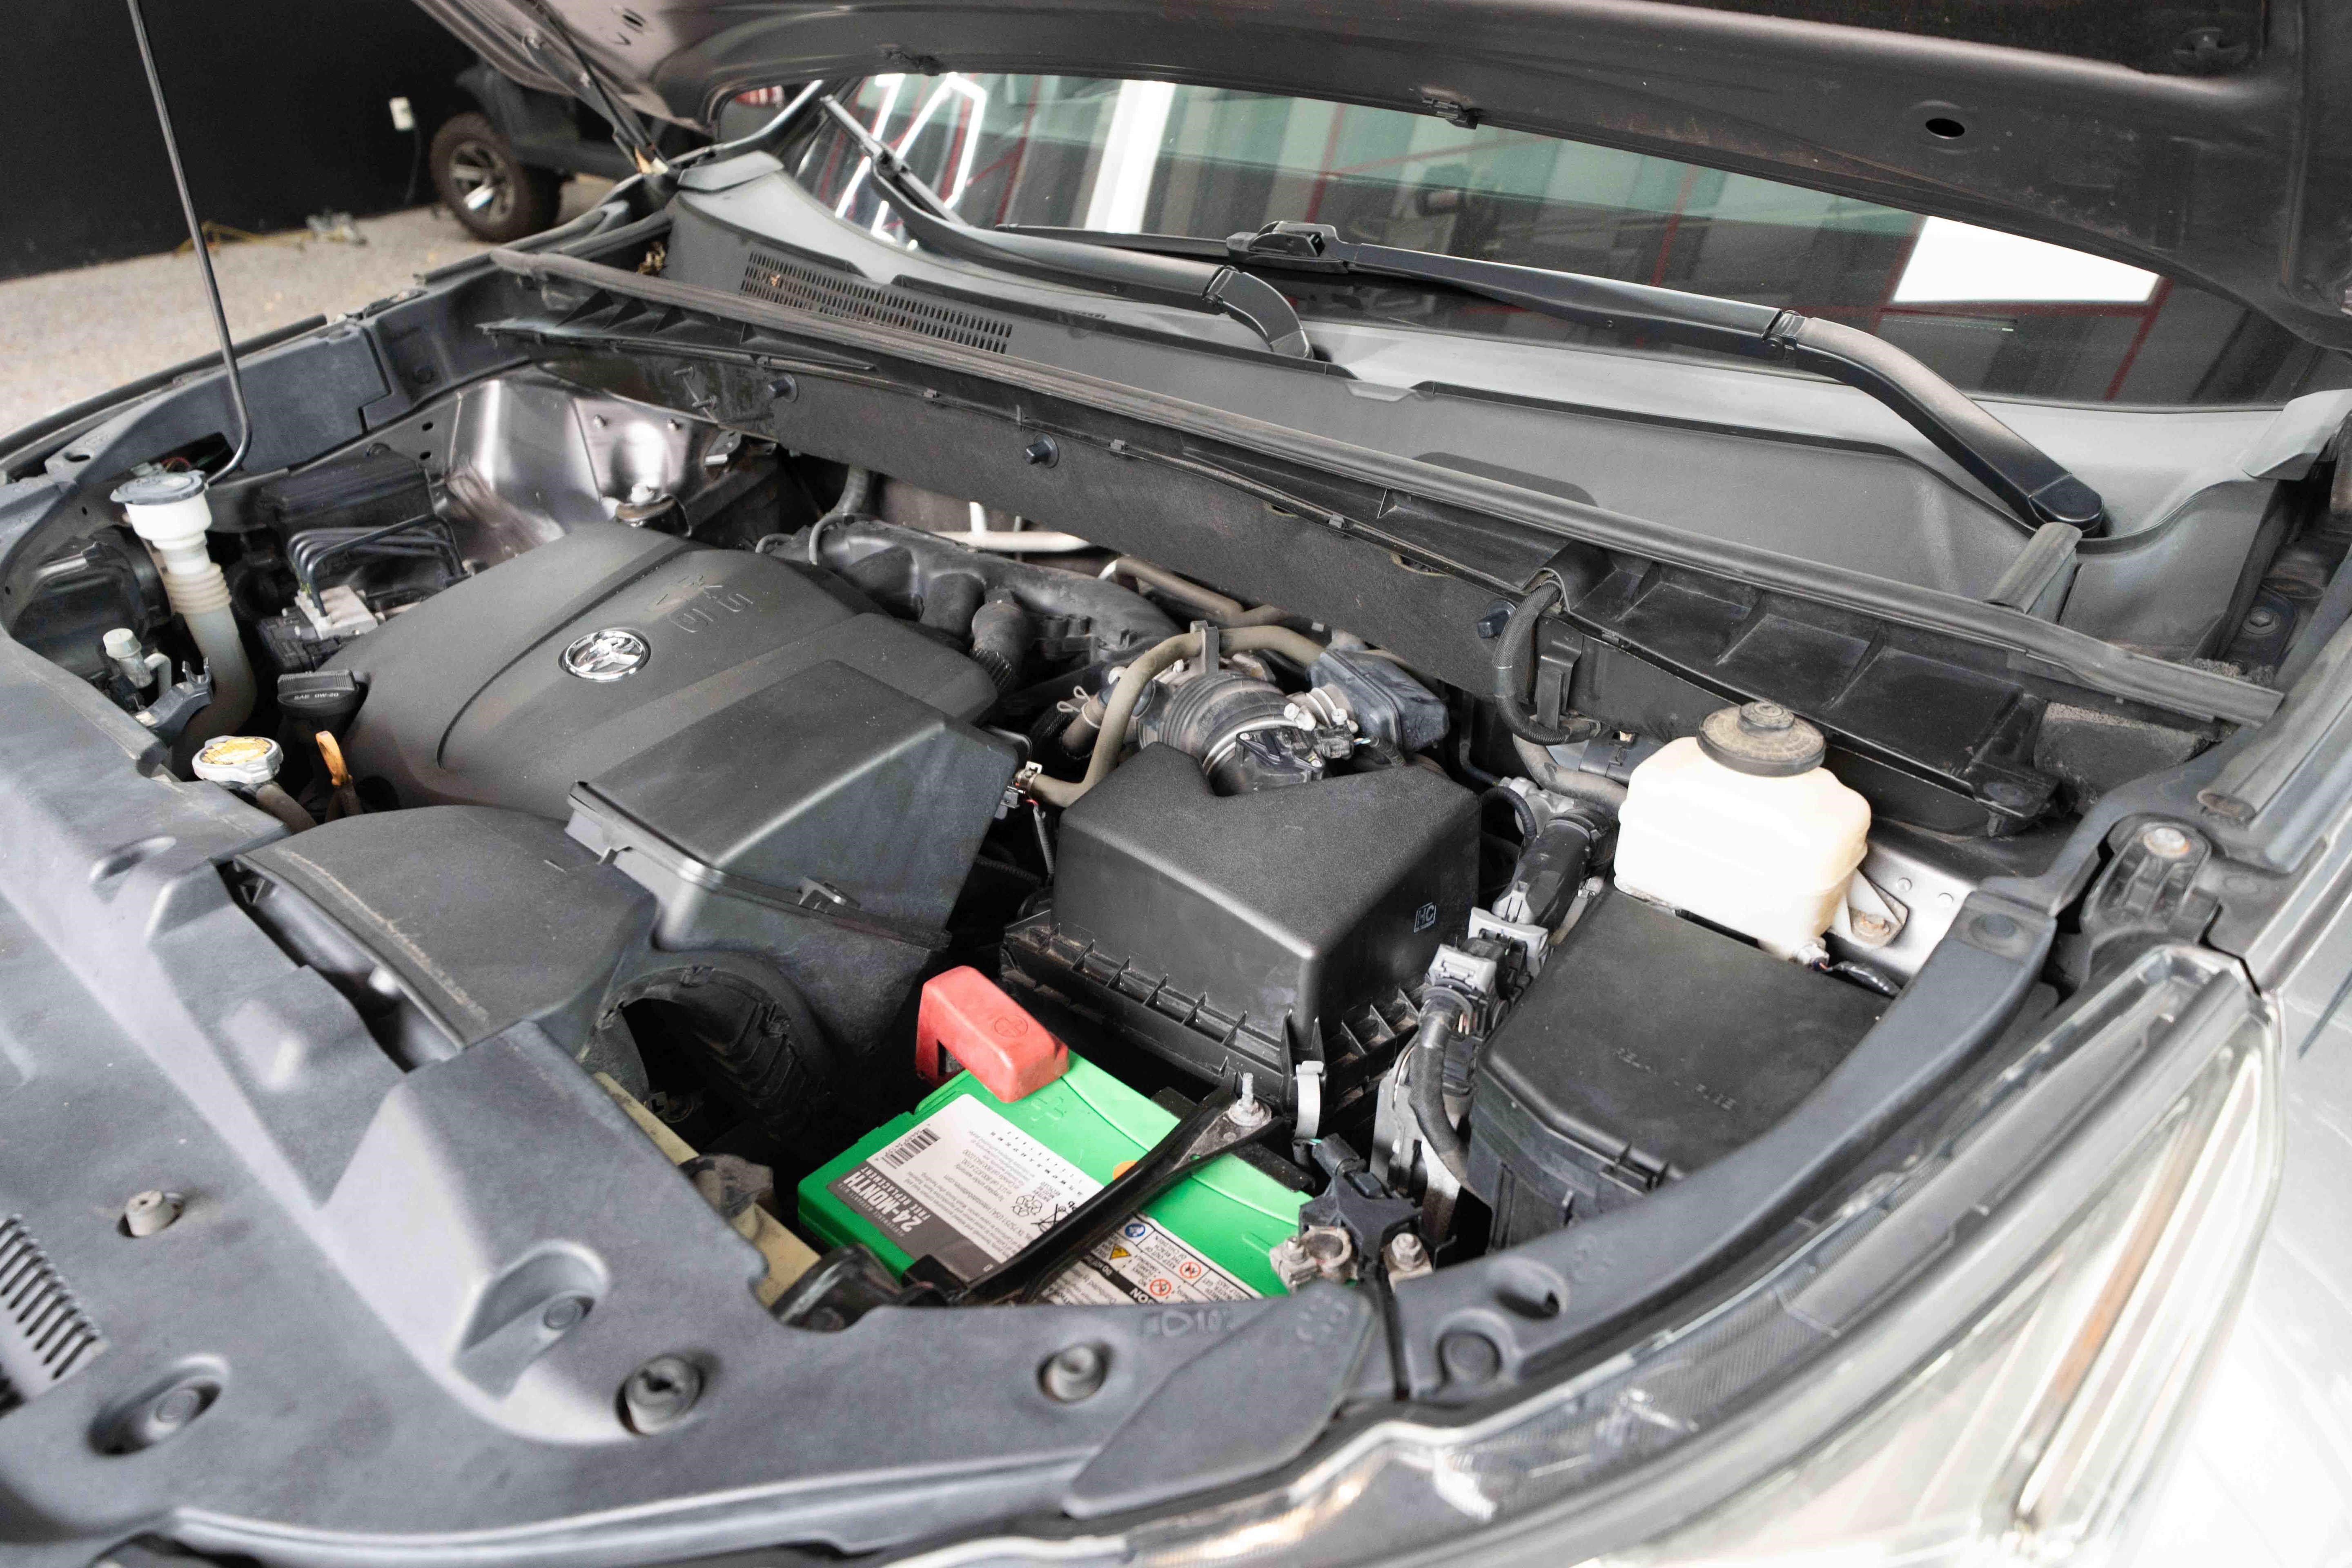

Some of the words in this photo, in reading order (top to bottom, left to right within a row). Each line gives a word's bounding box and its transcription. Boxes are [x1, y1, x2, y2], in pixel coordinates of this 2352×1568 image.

[860, 1166, 911, 1205] REPLACEMENT
[844, 1172, 922, 1232] 24-MONTH
[910, 1204, 930, 1221] FREE
[1163, 1259, 1176, 1269] KEEP
